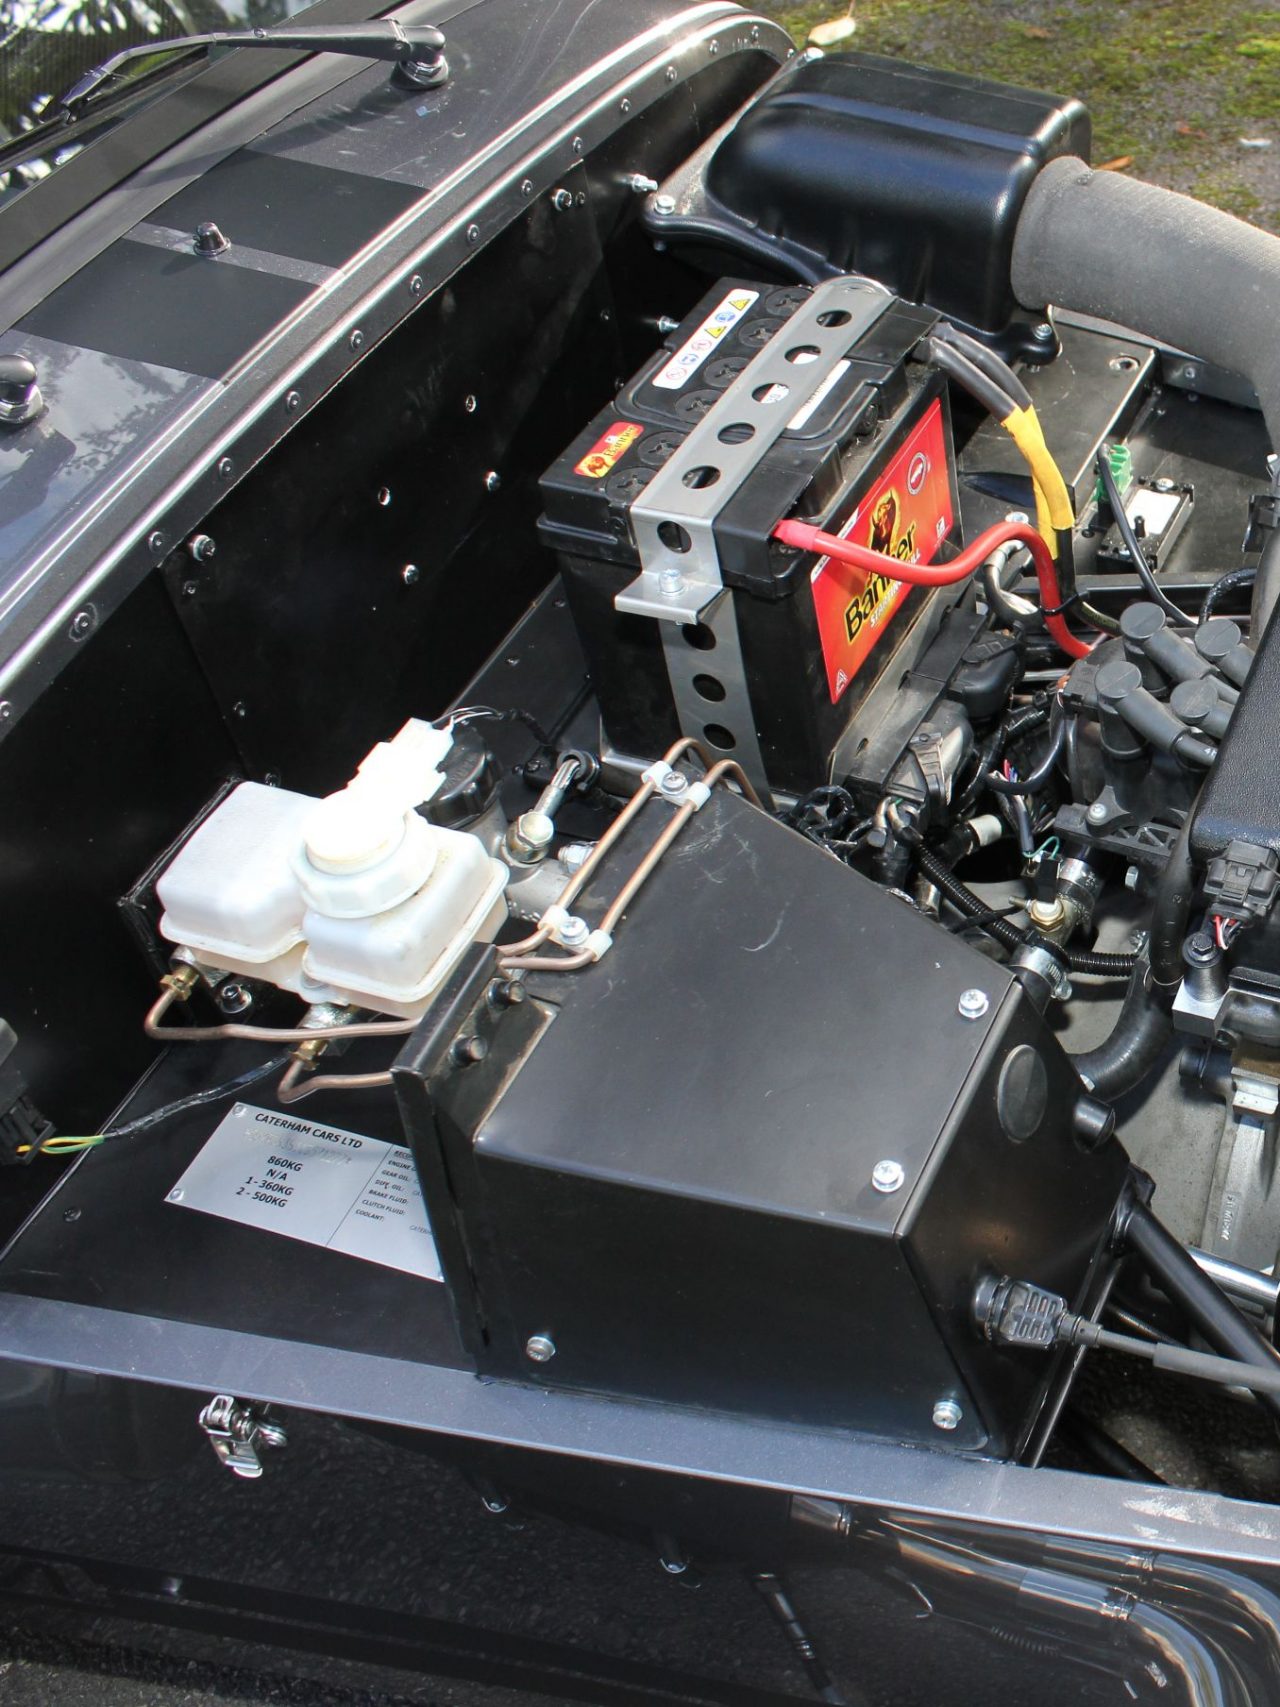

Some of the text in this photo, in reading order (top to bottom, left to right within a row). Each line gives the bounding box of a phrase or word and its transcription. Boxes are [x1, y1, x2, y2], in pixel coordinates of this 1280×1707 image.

[846, 525, 915, 643] Baner
[255, 1113, 363, 1149] CATERHAM CARS LTD
[267, 1155, 303, 1172] 860KG
[266, 1168, 289, 1181] N/A
[252, 1191, 288, 1208] 500KG
[362, 1199, 386, 1210] CLUTCH
